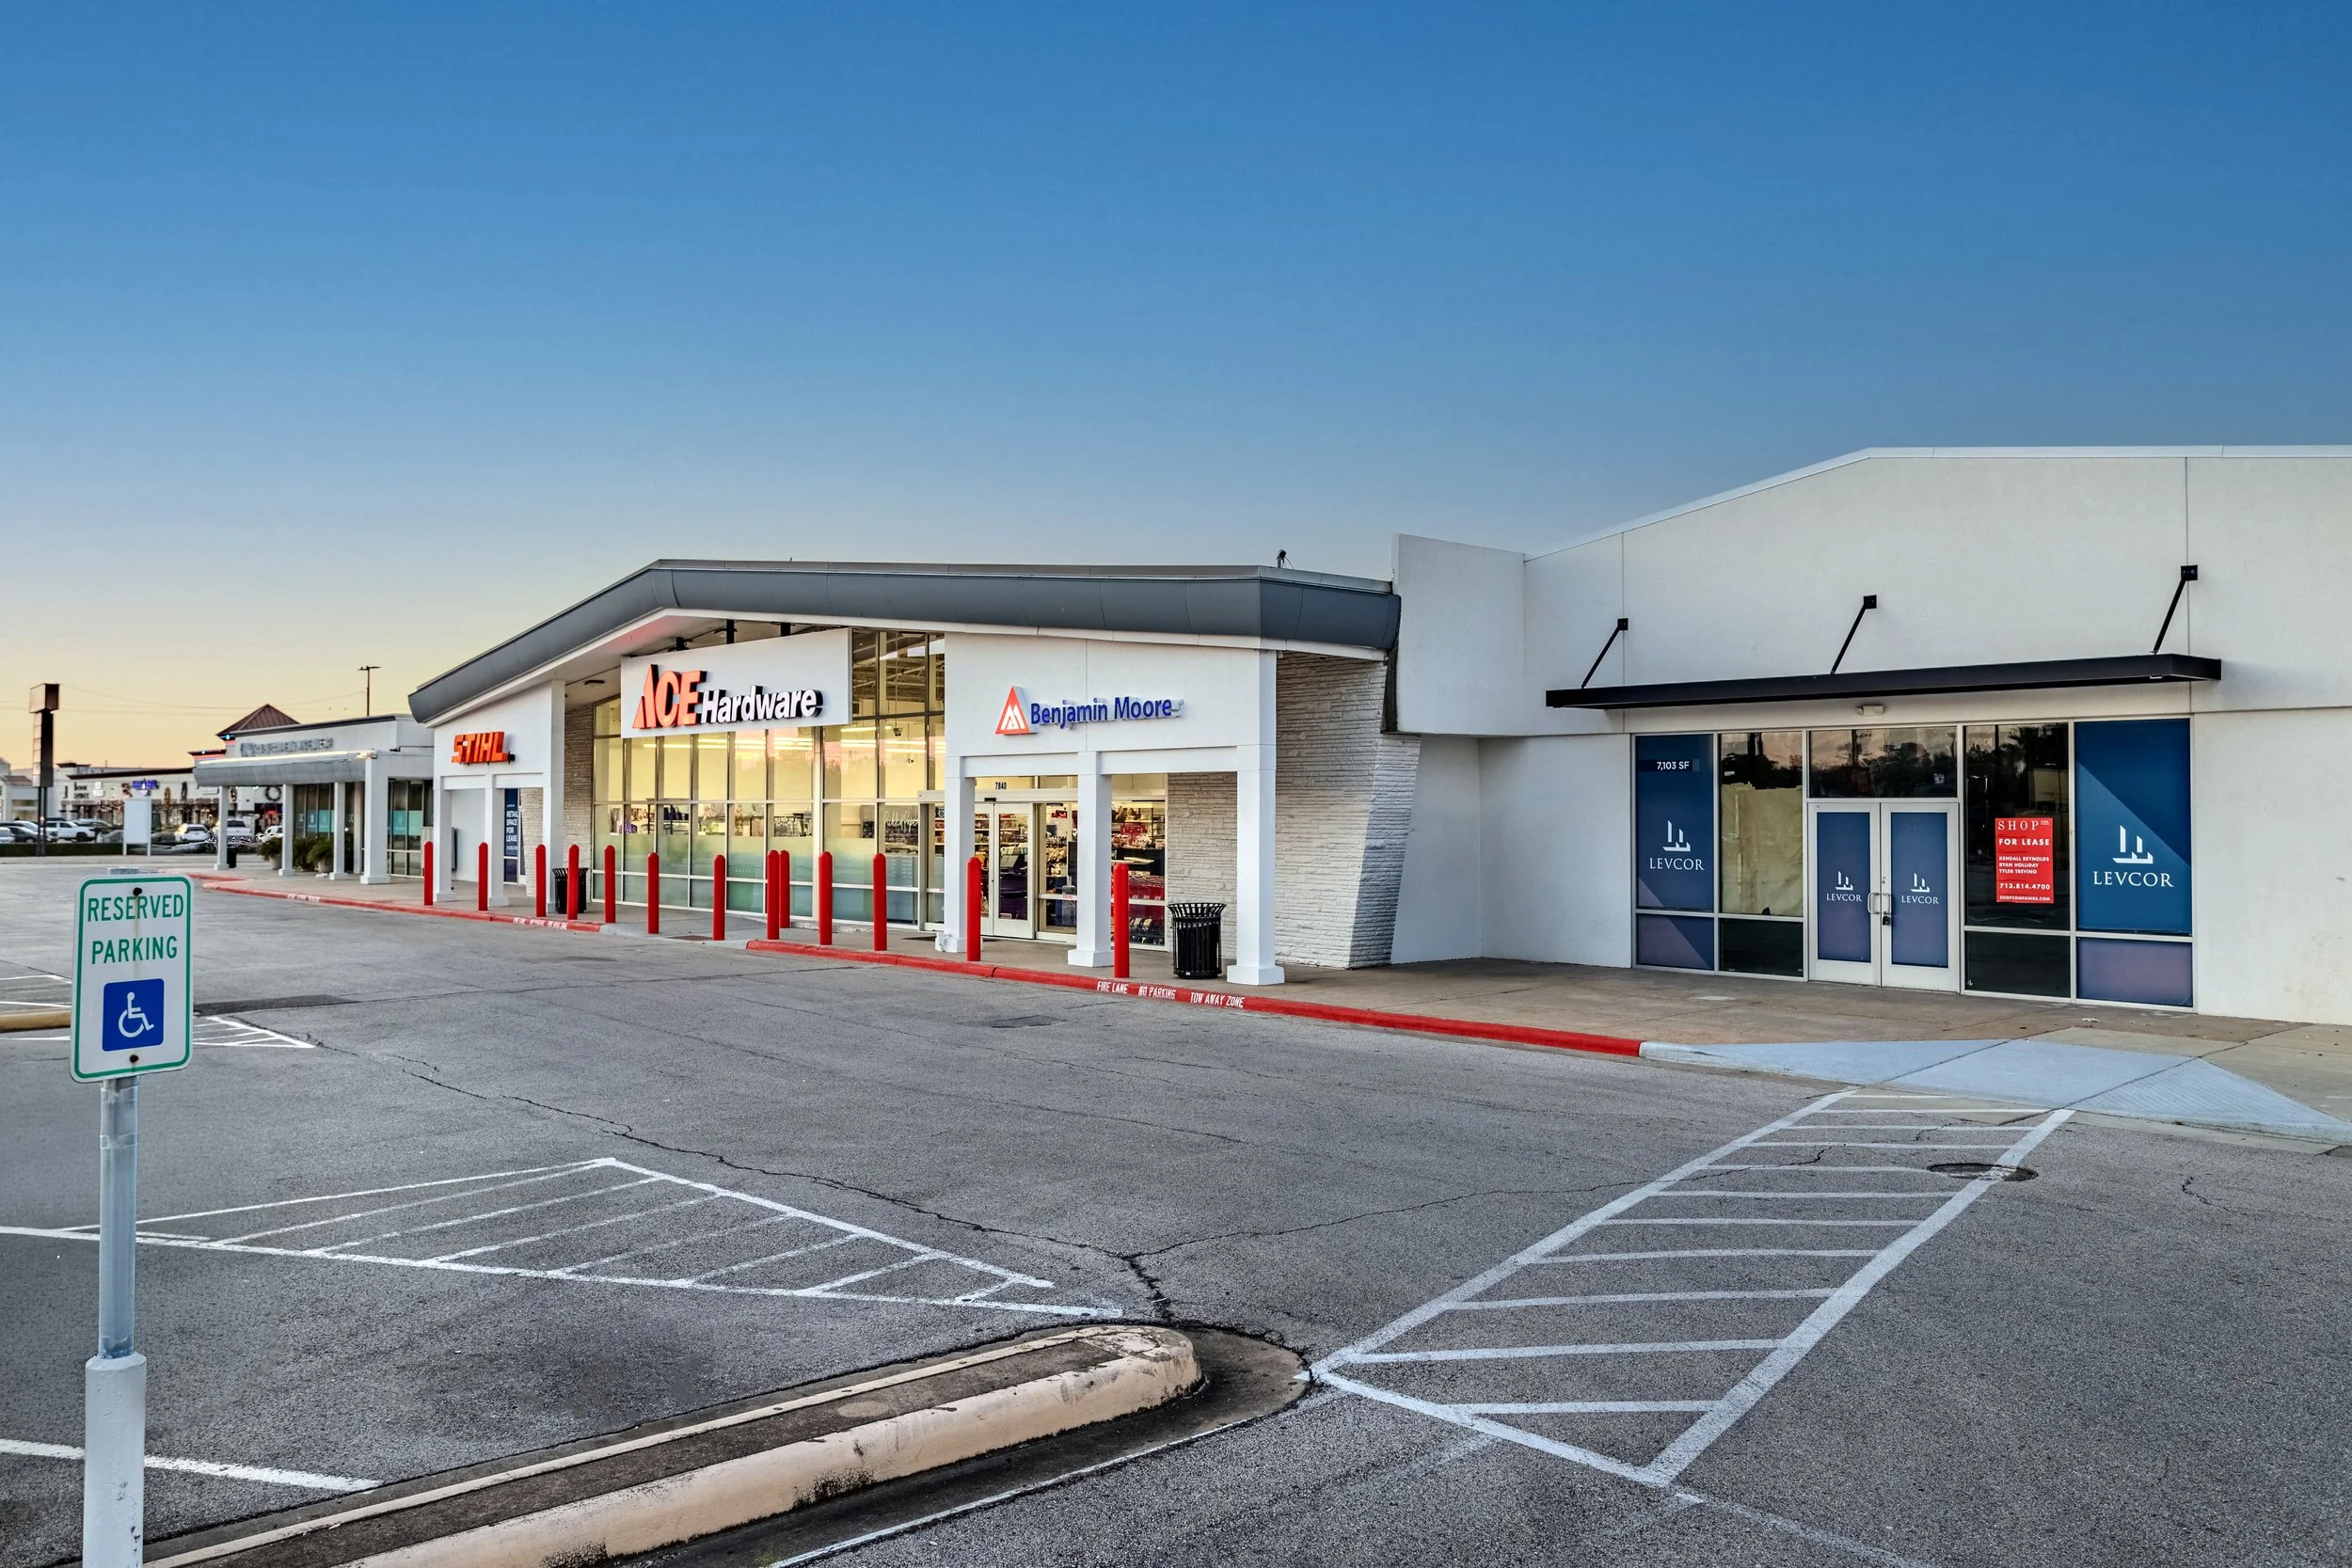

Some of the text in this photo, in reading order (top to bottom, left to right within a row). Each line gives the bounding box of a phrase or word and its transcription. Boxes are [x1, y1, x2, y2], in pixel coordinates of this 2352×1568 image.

[632, 663, 820, 729] ACE Hardware
[1030, 696, 1172, 729] Benjamin Moore
[452, 731, 509, 764] STIHL
[1656, 761, 1690, 771] 7,103 SF
[1997, 820, 2039, 831] SHOP
[1649, 857, 1705, 871] LEVCOR
[1999, 882, 2051, 891] 713.814.4700
[2092, 871, 2175, 888] LEVCOR
[1825, 893, 1863, 902] LEVCOR
[1900, 895, 1939, 905] LEVCOR
[87, 894, 184, 922] RESERVED
[91, 935, 178, 965] PARKING
[1096, 981, 1245, 1008] FIRE LANE NO PARKING TOW AWAY ZONE
